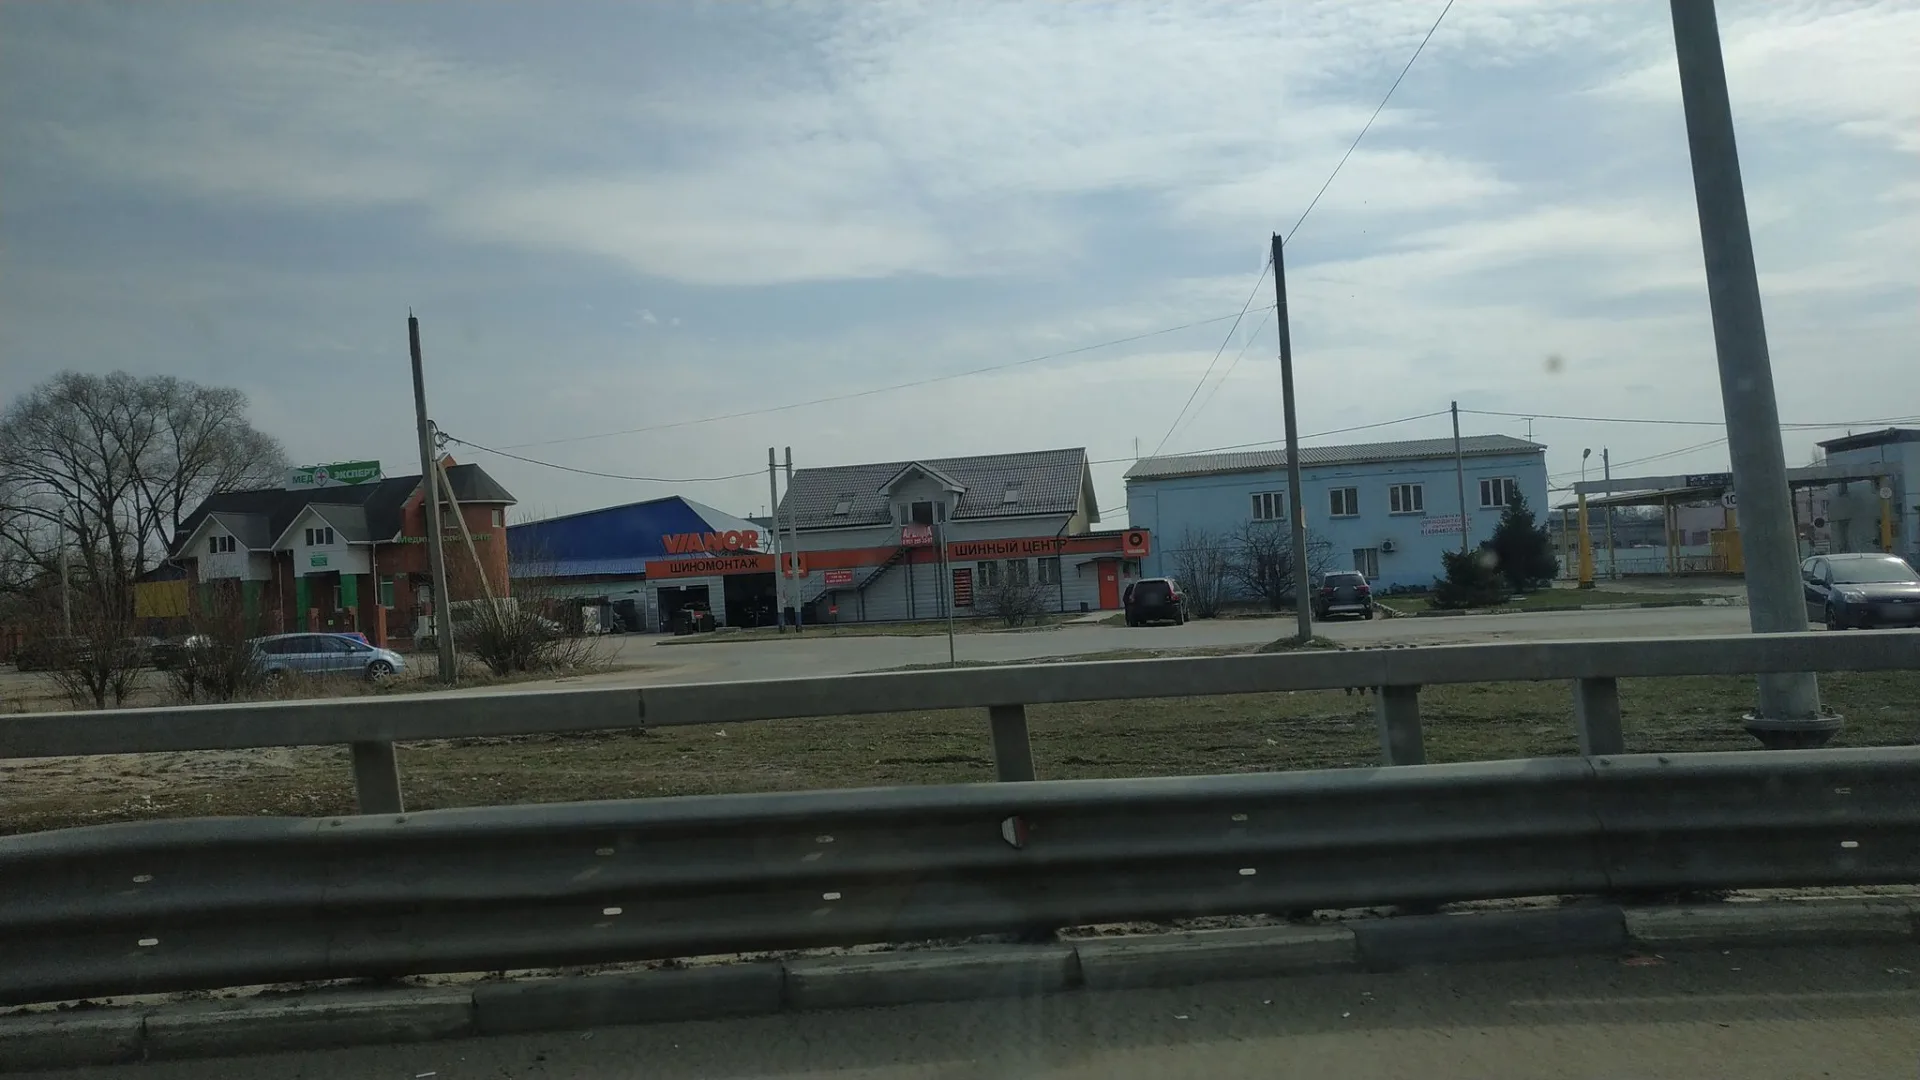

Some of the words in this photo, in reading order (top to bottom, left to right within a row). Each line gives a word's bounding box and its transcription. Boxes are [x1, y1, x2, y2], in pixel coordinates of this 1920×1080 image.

[292, 475, 314, 485] МЕД
[333, 467, 378, 480] ЭКСПЕРТ
[662, 530, 760, 553] VIANOR
[954, 540, 1018, 557] ШИННЫЙ
[1022, 538, 1068, 554] ЦЕНТР
[670, 558, 759, 574] ШИНОМОНТАЖ
